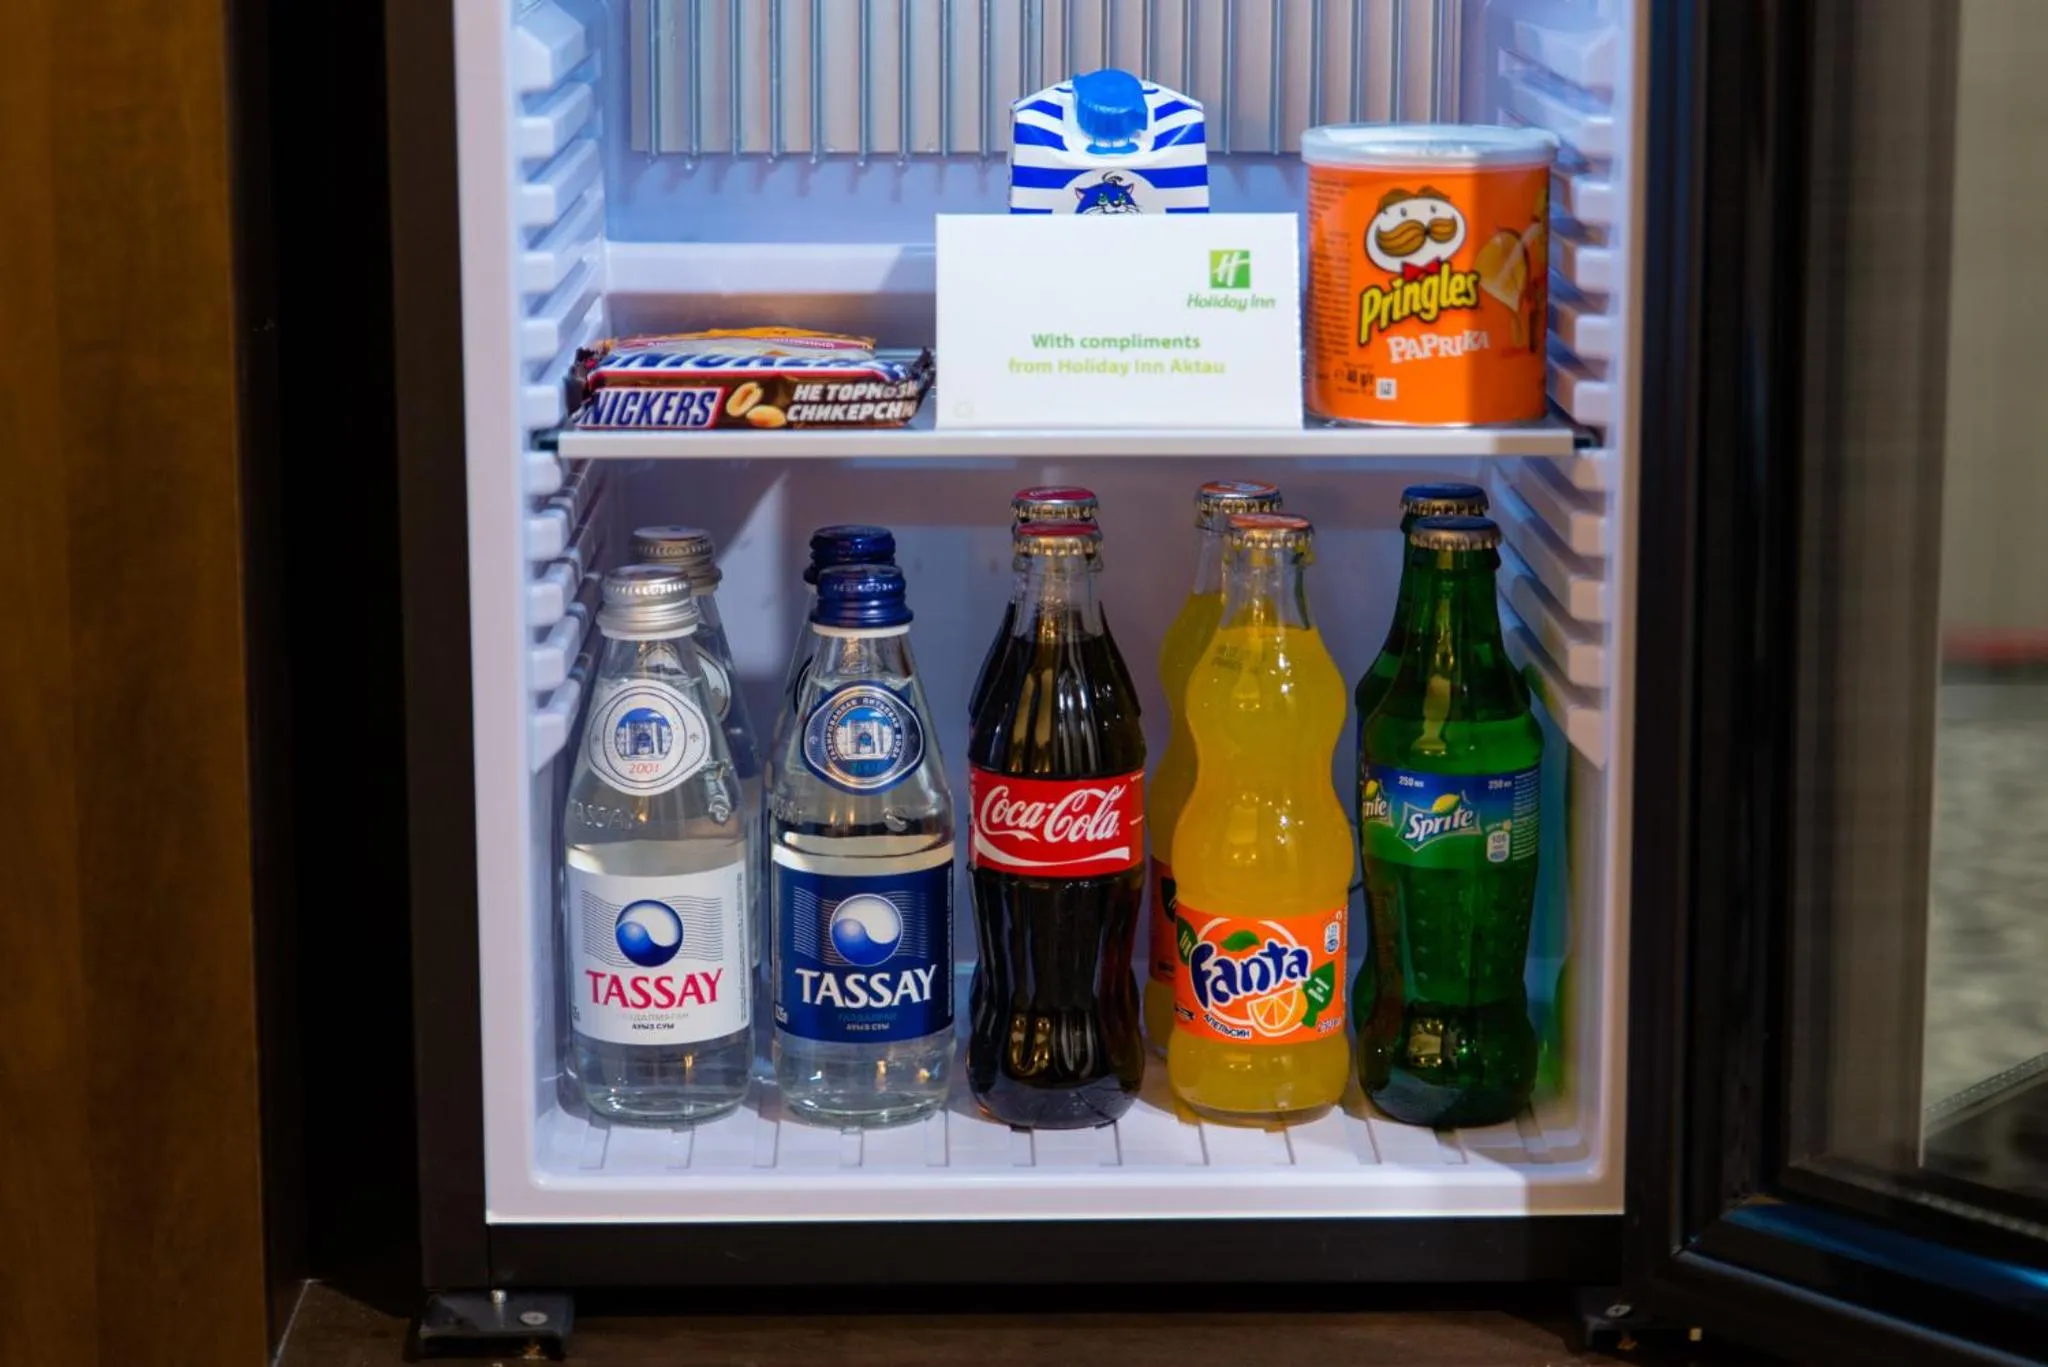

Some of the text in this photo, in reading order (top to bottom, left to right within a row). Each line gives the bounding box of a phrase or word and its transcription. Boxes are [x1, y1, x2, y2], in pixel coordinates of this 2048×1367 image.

[1187, 294, 1277, 311] Holiday Inn
[1358, 262, 1481, 347] Pringles
[1032, 333, 1202, 352] With compliments
[1387, 330, 1490, 364] PAPRIKA
[1008, 358, 1227, 377] from Holiday Inn Aktau
[579, 390, 718, 426] NICKERS
[793, 384, 824, 402] НЕ
[980, 784, 1127, 843] Coca-Cola
[1404, 805, 1475, 842] Sprite
[585, 968, 724, 1010] TASSAY
[794, 963, 938, 1009] TASSAY
[1189, 938, 1312, 1013] Fanta
[1203, 1013, 1251, 1039] АПЕЛЬСИН
